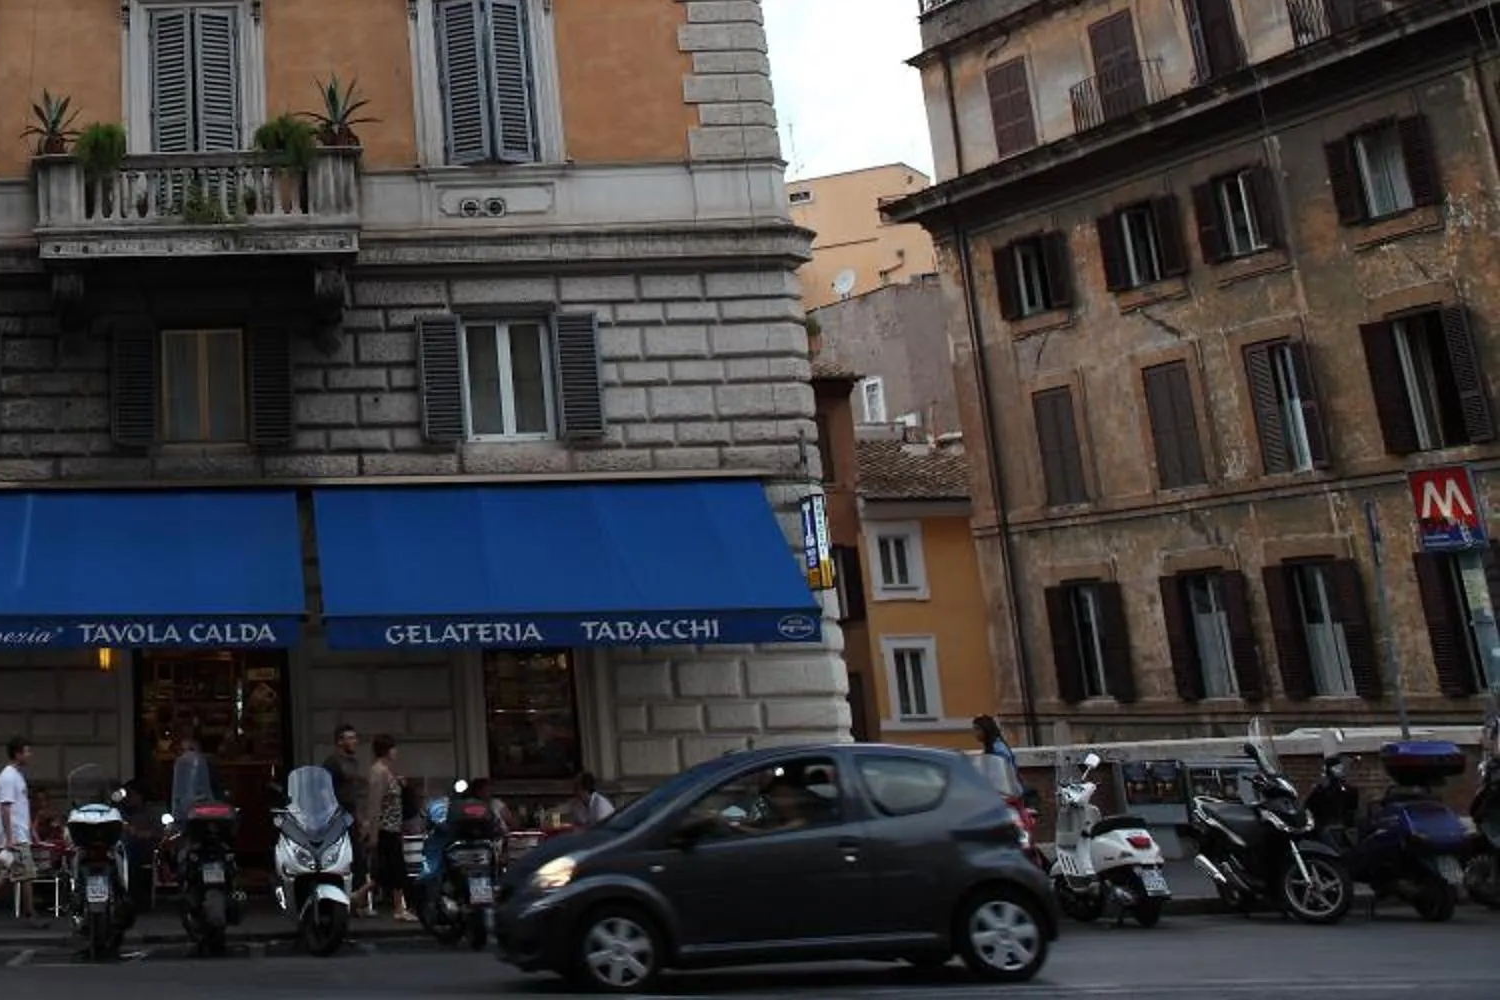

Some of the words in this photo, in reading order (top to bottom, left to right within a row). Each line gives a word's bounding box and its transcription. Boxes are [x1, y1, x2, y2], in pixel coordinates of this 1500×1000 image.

[1421, 478, 1473, 519] M
[77, 623, 183, 643] TAVOLA
[188, 622, 277, 643] CALDA
[385, 622, 543, 645] GELATERIA
[580, 619, 719, 641] TABACCHI
